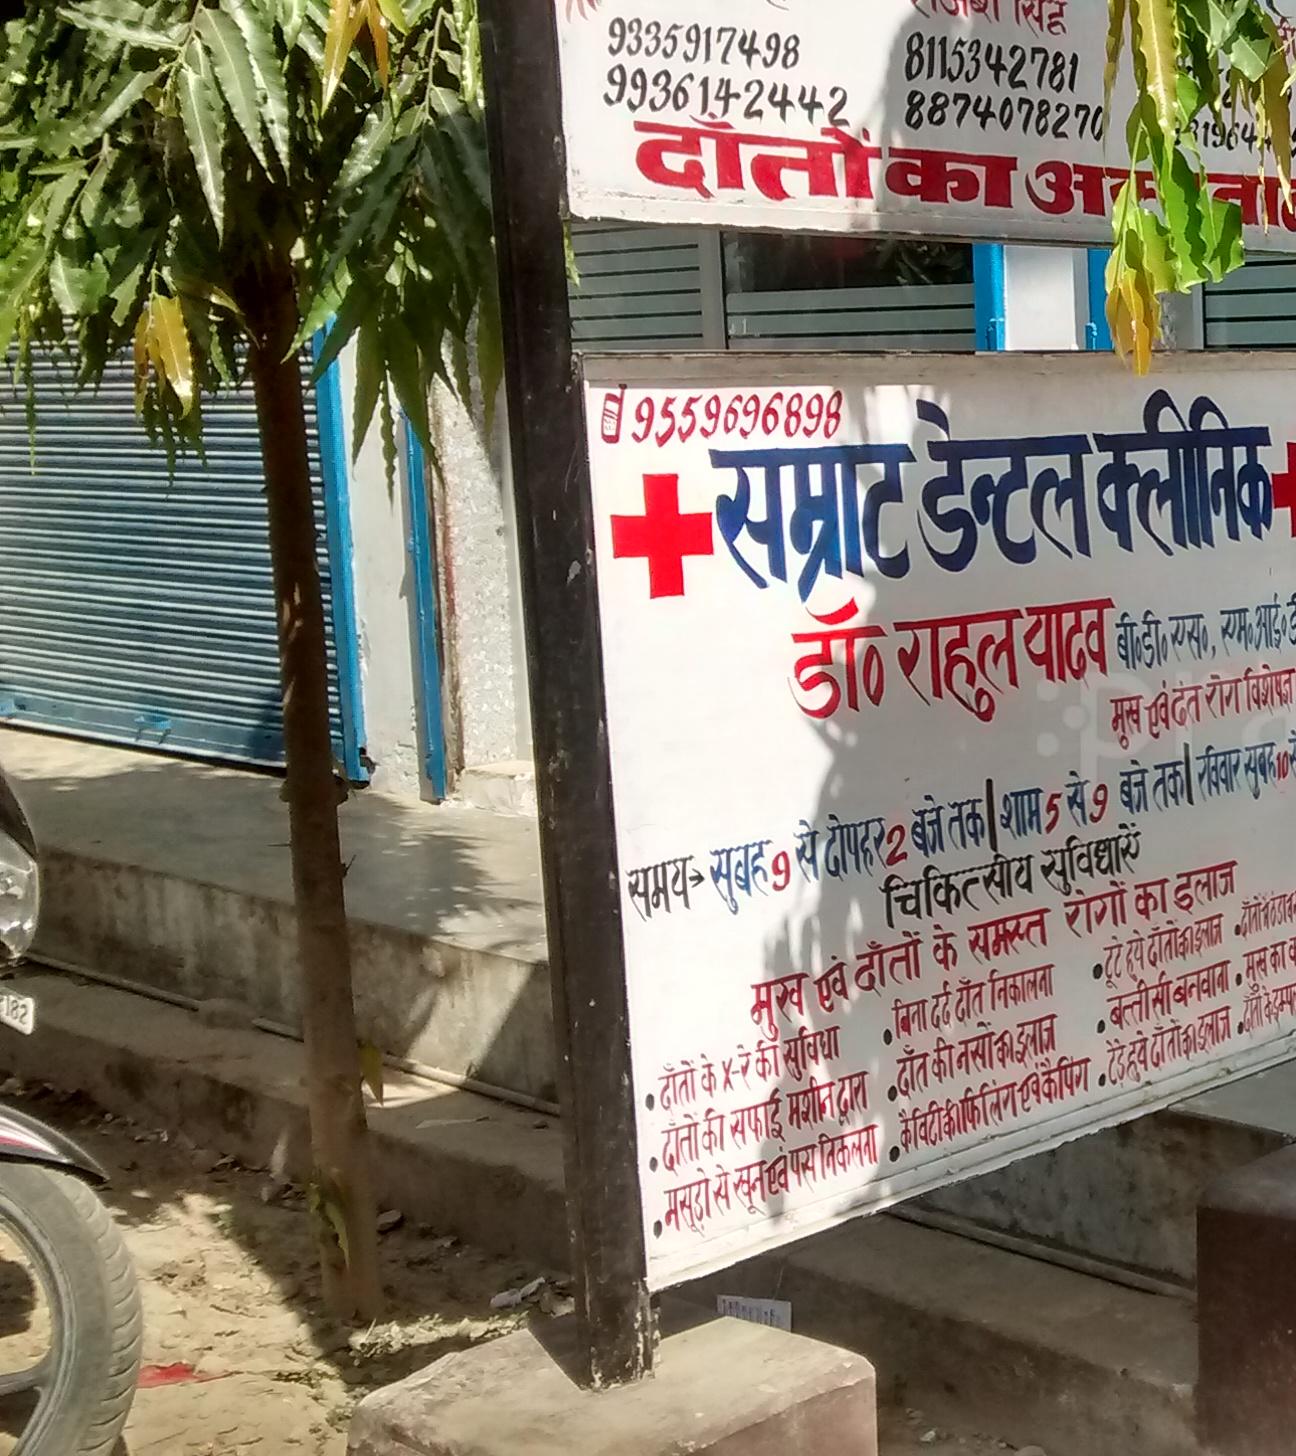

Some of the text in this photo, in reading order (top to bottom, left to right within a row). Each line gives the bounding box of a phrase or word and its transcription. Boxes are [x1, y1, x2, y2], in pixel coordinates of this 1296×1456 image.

[607, 17, 800, 69] 9335917498
[905, 31, 1079, 93] 8115342781
[602, 63, 850, 127] 9936142442
[905, 89, 1104, 141] 8874078270
[885, 147, 1018, 209] का
[631, 389, 844, 448] 9559696898
[707, 388, 1273, 603] सम्राट डेन्टल क्लीनिक
[892, 608, 1025, 723] राहुल
[1022, 597, 1116, 688] यादव
[1110, 695, 1143, 750] मुख
[1204, 674, 1243, 719] रोग
[709, 839, 775, 916] सुबह
[770, 850, 791, 892] 9
[793, 819, 819, 884] से
[824, 813, 888, 882] दोपहर
[886, 824, 908, 868] 2
[911, 795, 945, 858] बजे
[1000, 787, 1043, 840] शाम
[1044, 793, 1063, 834] 5
[1064, 770, 1090, 827] से
[1088, 783, 1109, 824] 9
[1118, 760, 1150, 814] बजे
[1276, 750, 1290, 781] 10
[750, 973, 809, 1042] मुख
[813, 956, 849, 1013] एवं
[932, 924, 958, 972] के
[967, 908, 1052, 964] समस्त
[1064, 880, 1129, 939] रोगों
[1134, 878, 1171, 921] का
[1174, 860, 1239, 915] इलाज
[0, 995, 28, 1026] 182
[892, 998, 929, 1039] बिना
[783, 1026, 842, 1082] सुविधा
